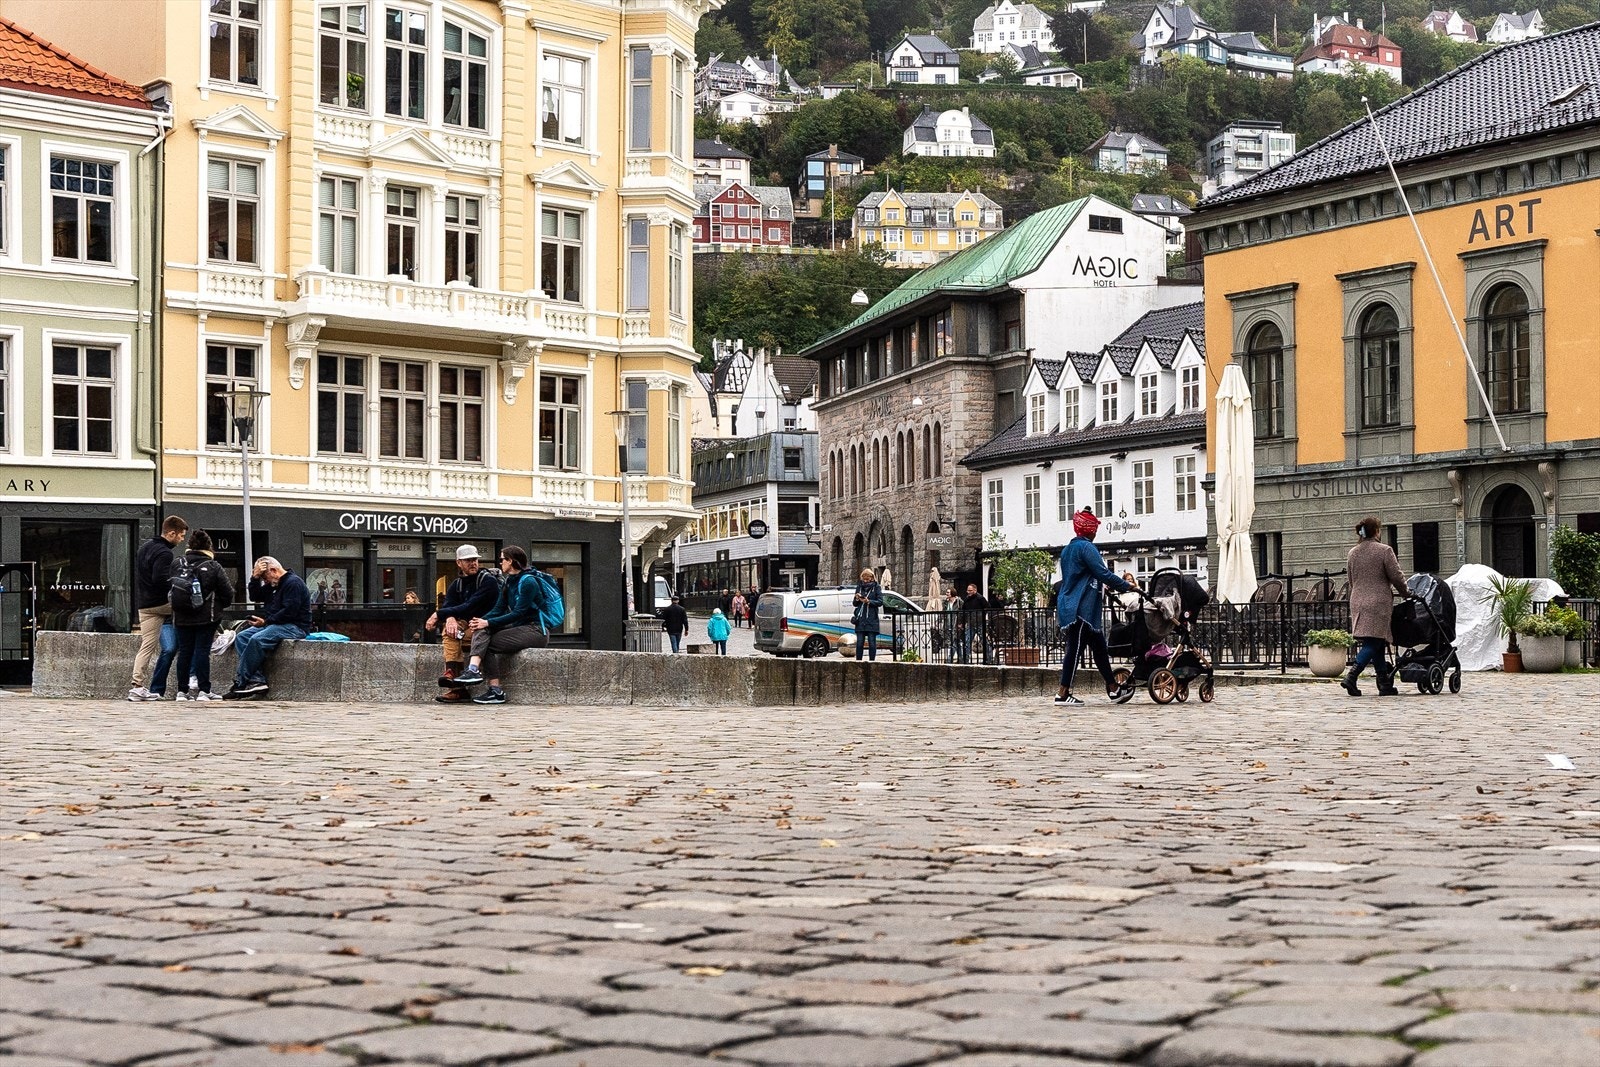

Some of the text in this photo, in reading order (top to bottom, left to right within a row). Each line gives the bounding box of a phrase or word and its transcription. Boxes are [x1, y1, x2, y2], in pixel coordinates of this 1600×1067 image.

[1467, 197, 1542, 245] ART
[1071, 254, 1139, 280] MAGIC
[1093, 279, 1117, 288] HOTEL
[6, 479, 51, 492] ARY
[1292, 475, 1404, 499] UTSTILLINGER
[339, 512, 469, 535] OPTIKER SVABØ
[217, 538, 229, 549] 10
[929, 536, 952, 544] MAGIC
[312, 542, 348, 551] SOLBRILLER
[388, 544, 412, 552] BRILLER
[800, 599, 818, 609] VB
